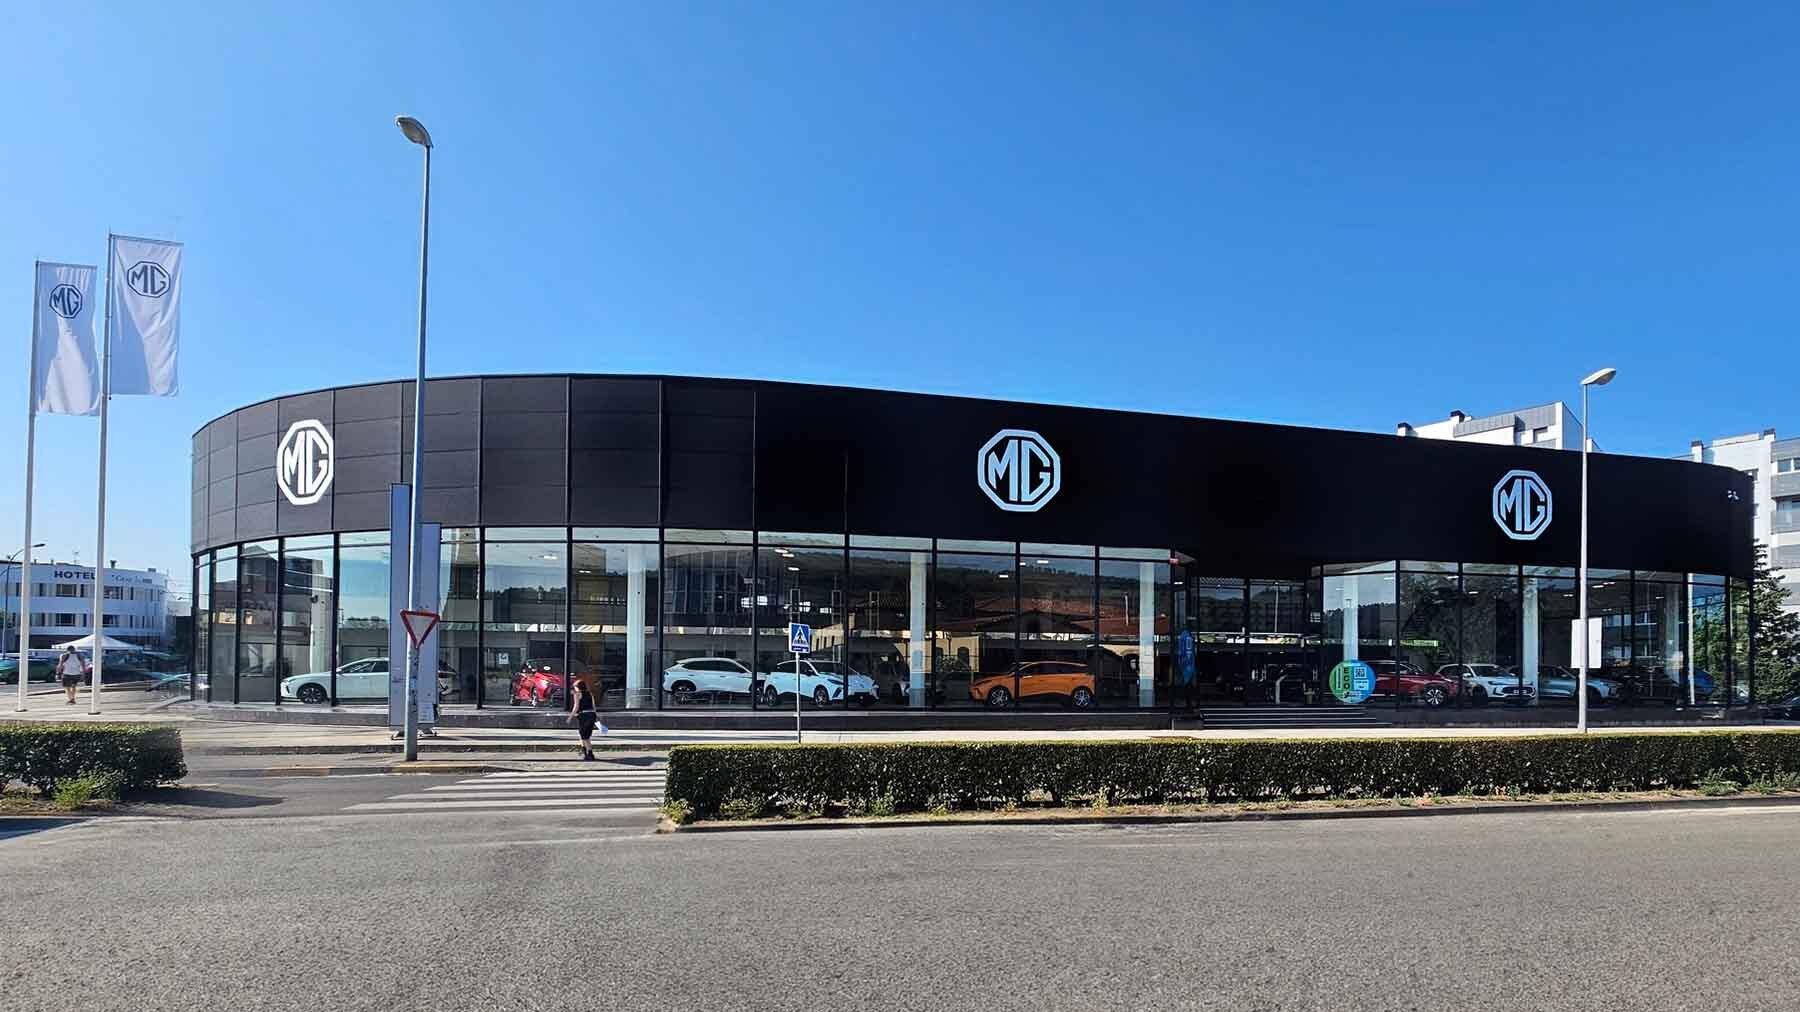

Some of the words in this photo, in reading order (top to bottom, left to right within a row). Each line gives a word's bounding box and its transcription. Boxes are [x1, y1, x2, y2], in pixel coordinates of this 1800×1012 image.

[130, 264, 167, 295] MG
[52, 287, 80, 316] MG
[283, 430, 329, 495] MG
[988, 439, 1051, 502] MG
[1501, 478, 1545, 531] MG
[54, 570, 95, 580] HOTEL
